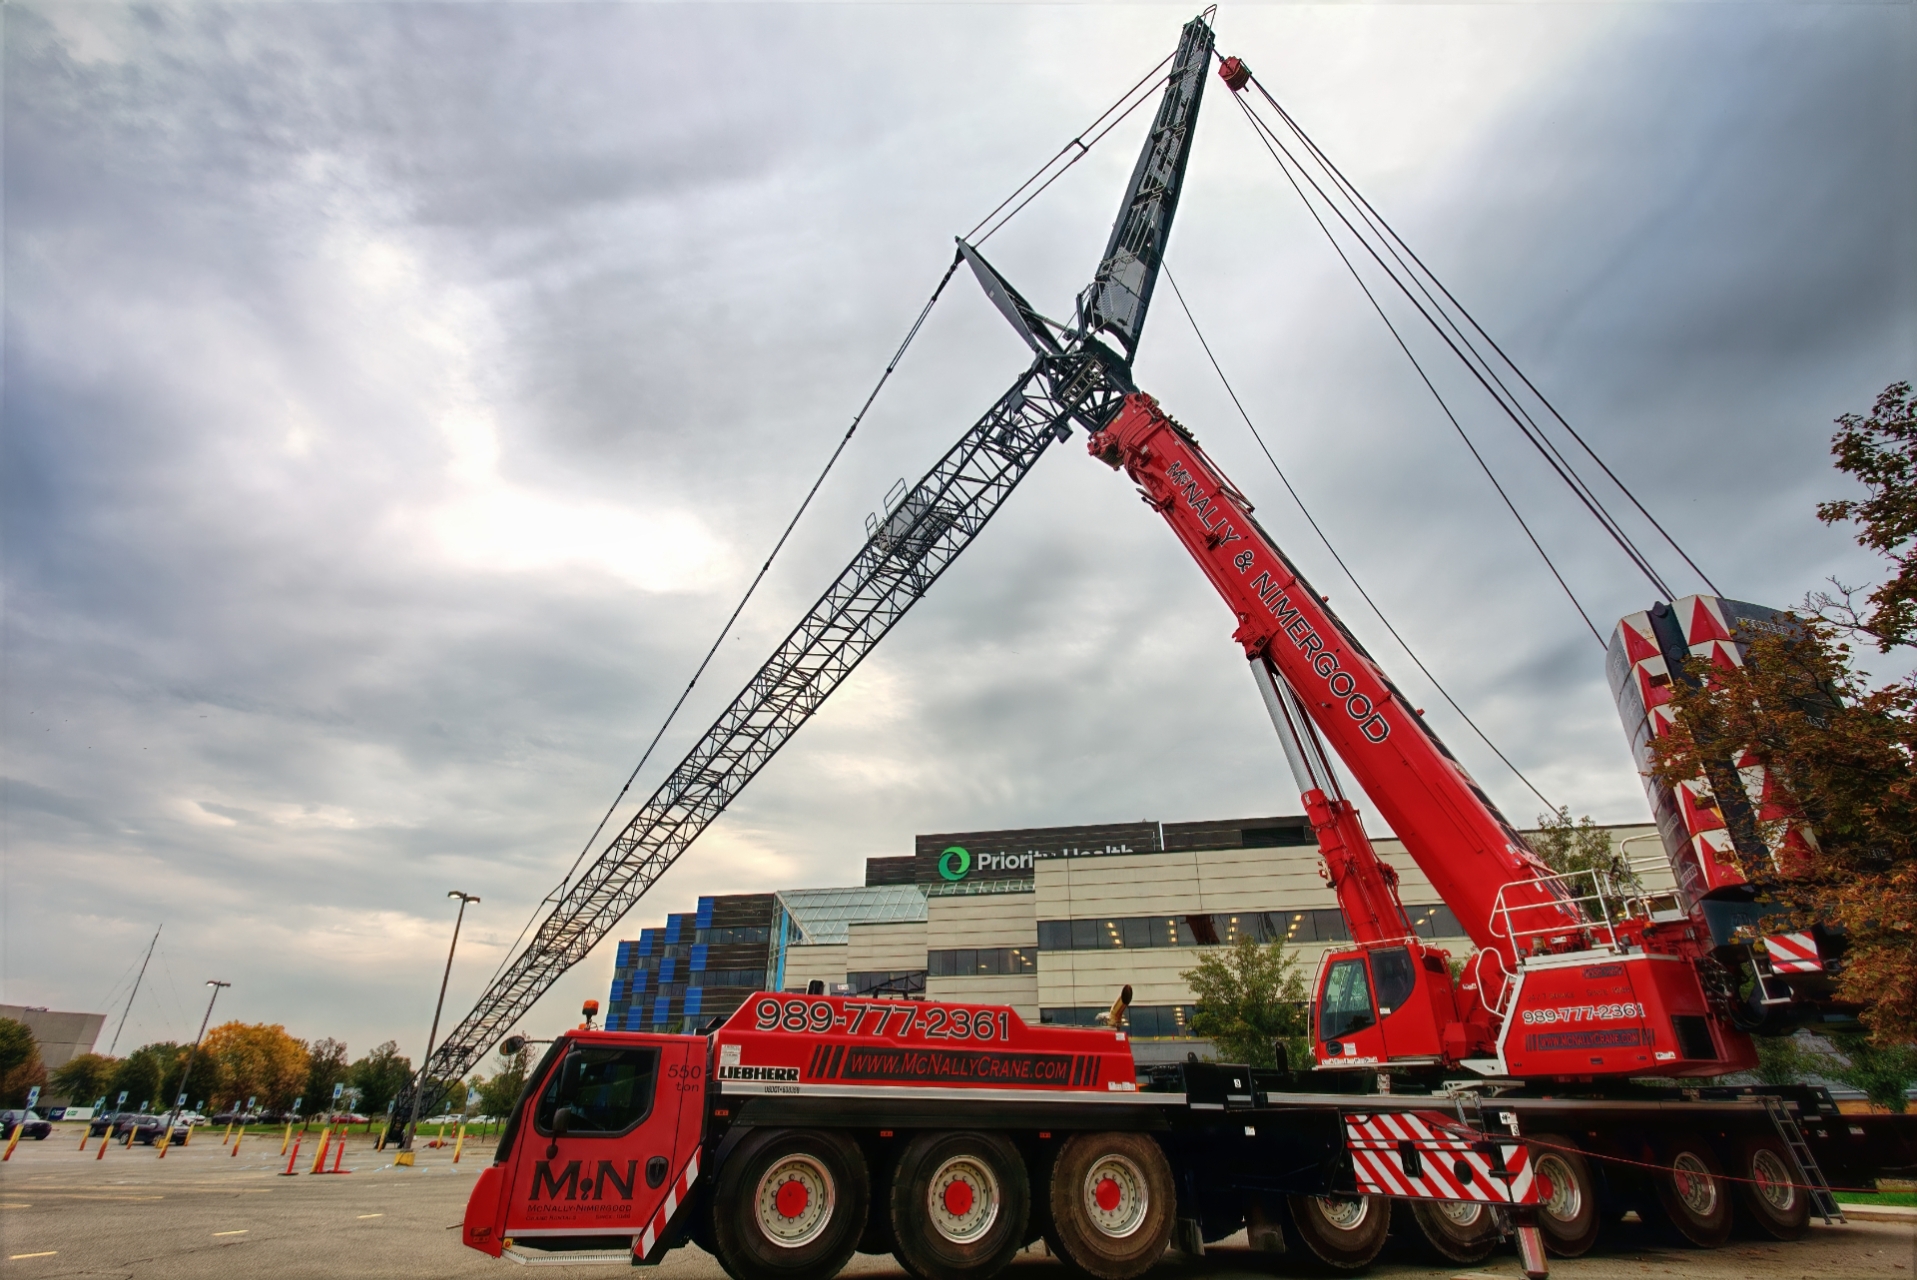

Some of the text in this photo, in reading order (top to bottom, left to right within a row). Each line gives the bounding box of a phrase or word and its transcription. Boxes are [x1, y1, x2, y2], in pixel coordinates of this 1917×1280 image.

[1233, 550, 1254, 574] &
[1250, 570, 1391, 744] NIMERGOOD
[978, 850, 1056, 870] Priori
[756, 999, 1010, 1042] 989-777-2361
[1522, 1002, 1646, 1025] 989-777-2361
[667, 1064, 701, 1079] 550
[718, 1066, 799, 1082] LIEBHERR
[850, 1053, 1068, 1079] WWW.MCNALLYCRANE.COM
[675, 1081, 699, 1092] ton
